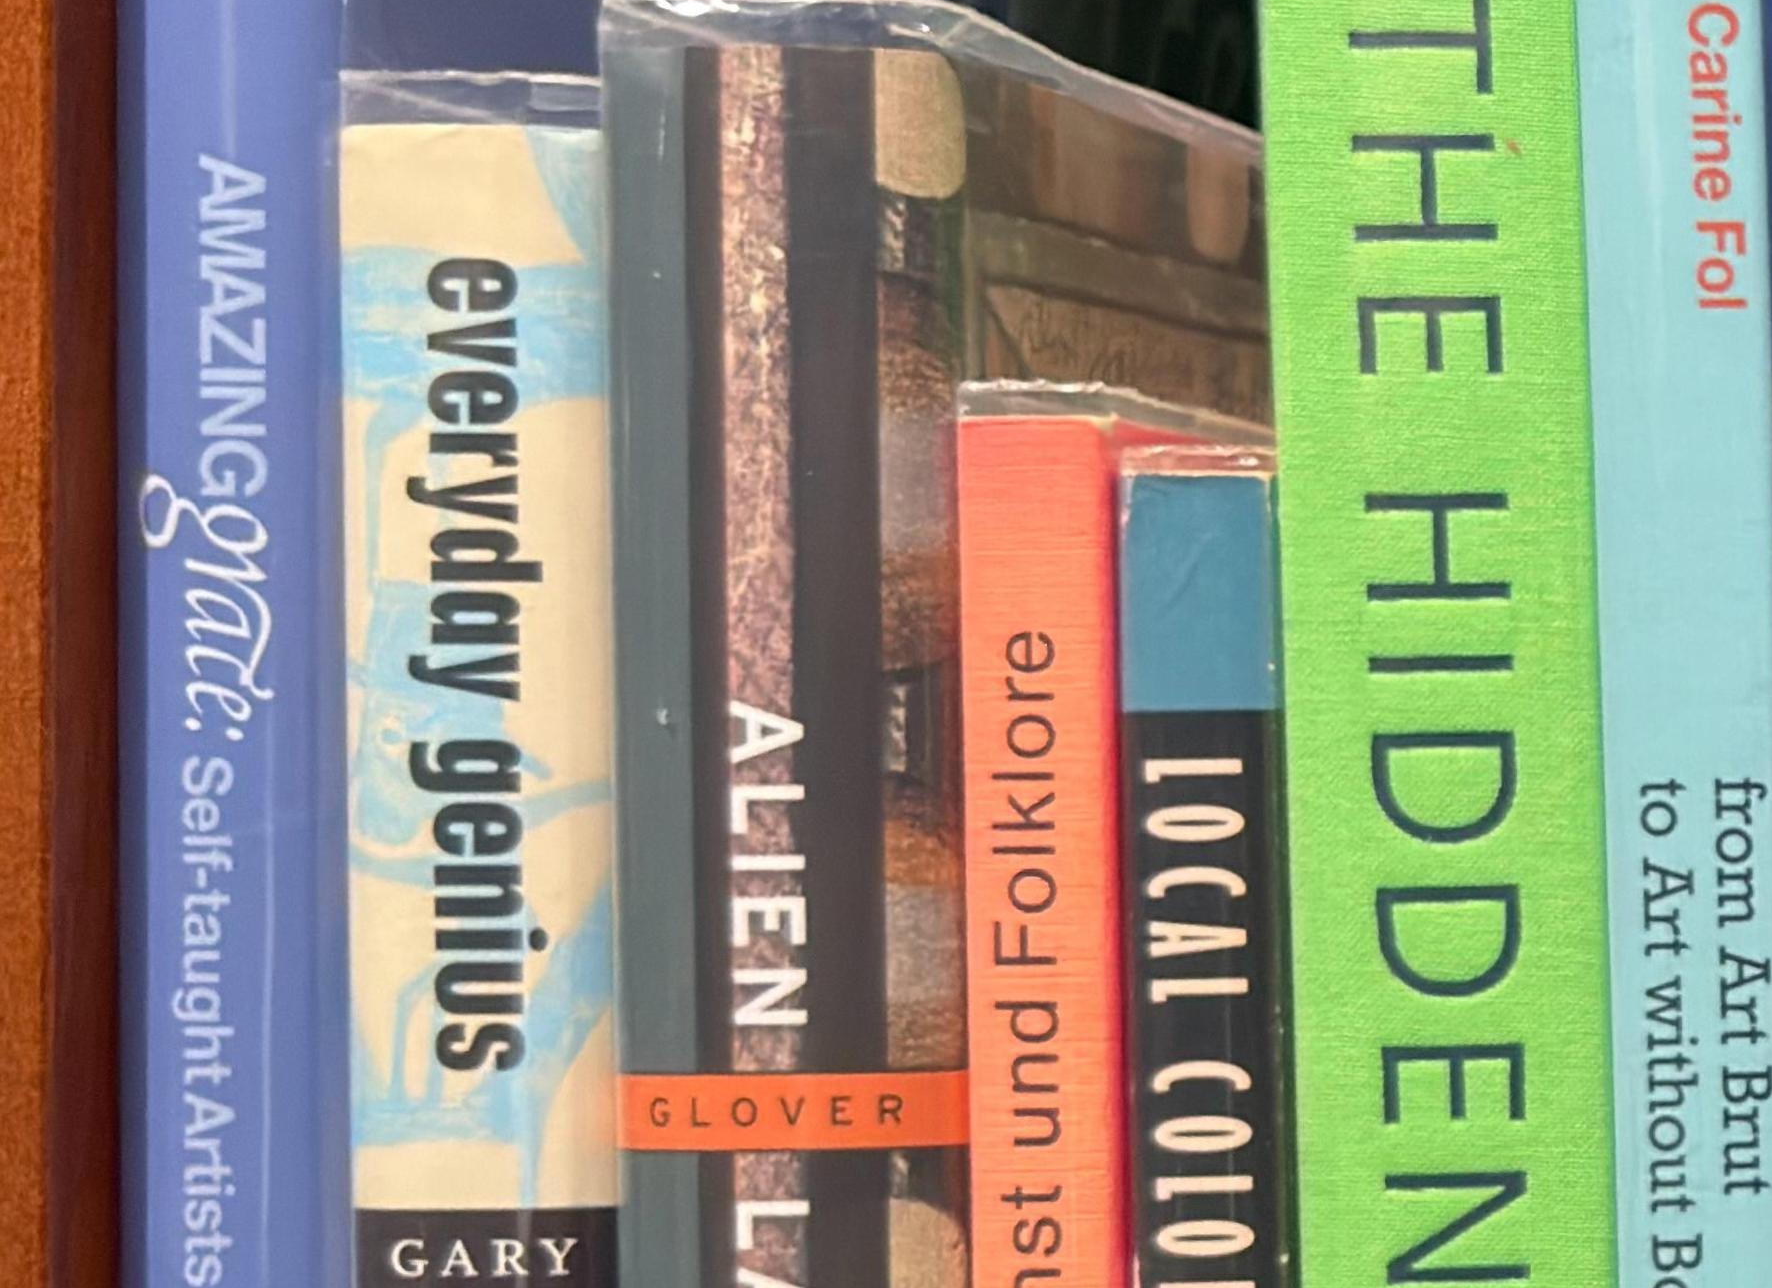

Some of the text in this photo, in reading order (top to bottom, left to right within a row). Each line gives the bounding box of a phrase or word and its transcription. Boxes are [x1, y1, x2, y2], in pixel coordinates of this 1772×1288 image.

[1687, 1, 1747, 310] Carine Fol
[406, 258, 549, 1071] everyday genius
[992, 631, 1057, 968] Folklore
[173, 756, 235, 1085] Self-taught
[729, 699, 809, 1027] ALIEN
[1144, 758, 1249, 1003] LOCAL
[1363, 492, 1533, 1287] HIDDEN
[180, 1093, 235, 1287] Artists
[648, 1097, 905, 1127] GLOVER
[995, 1001, 1064, 1148] und
[391, 1239, 576, 1275] GARY
